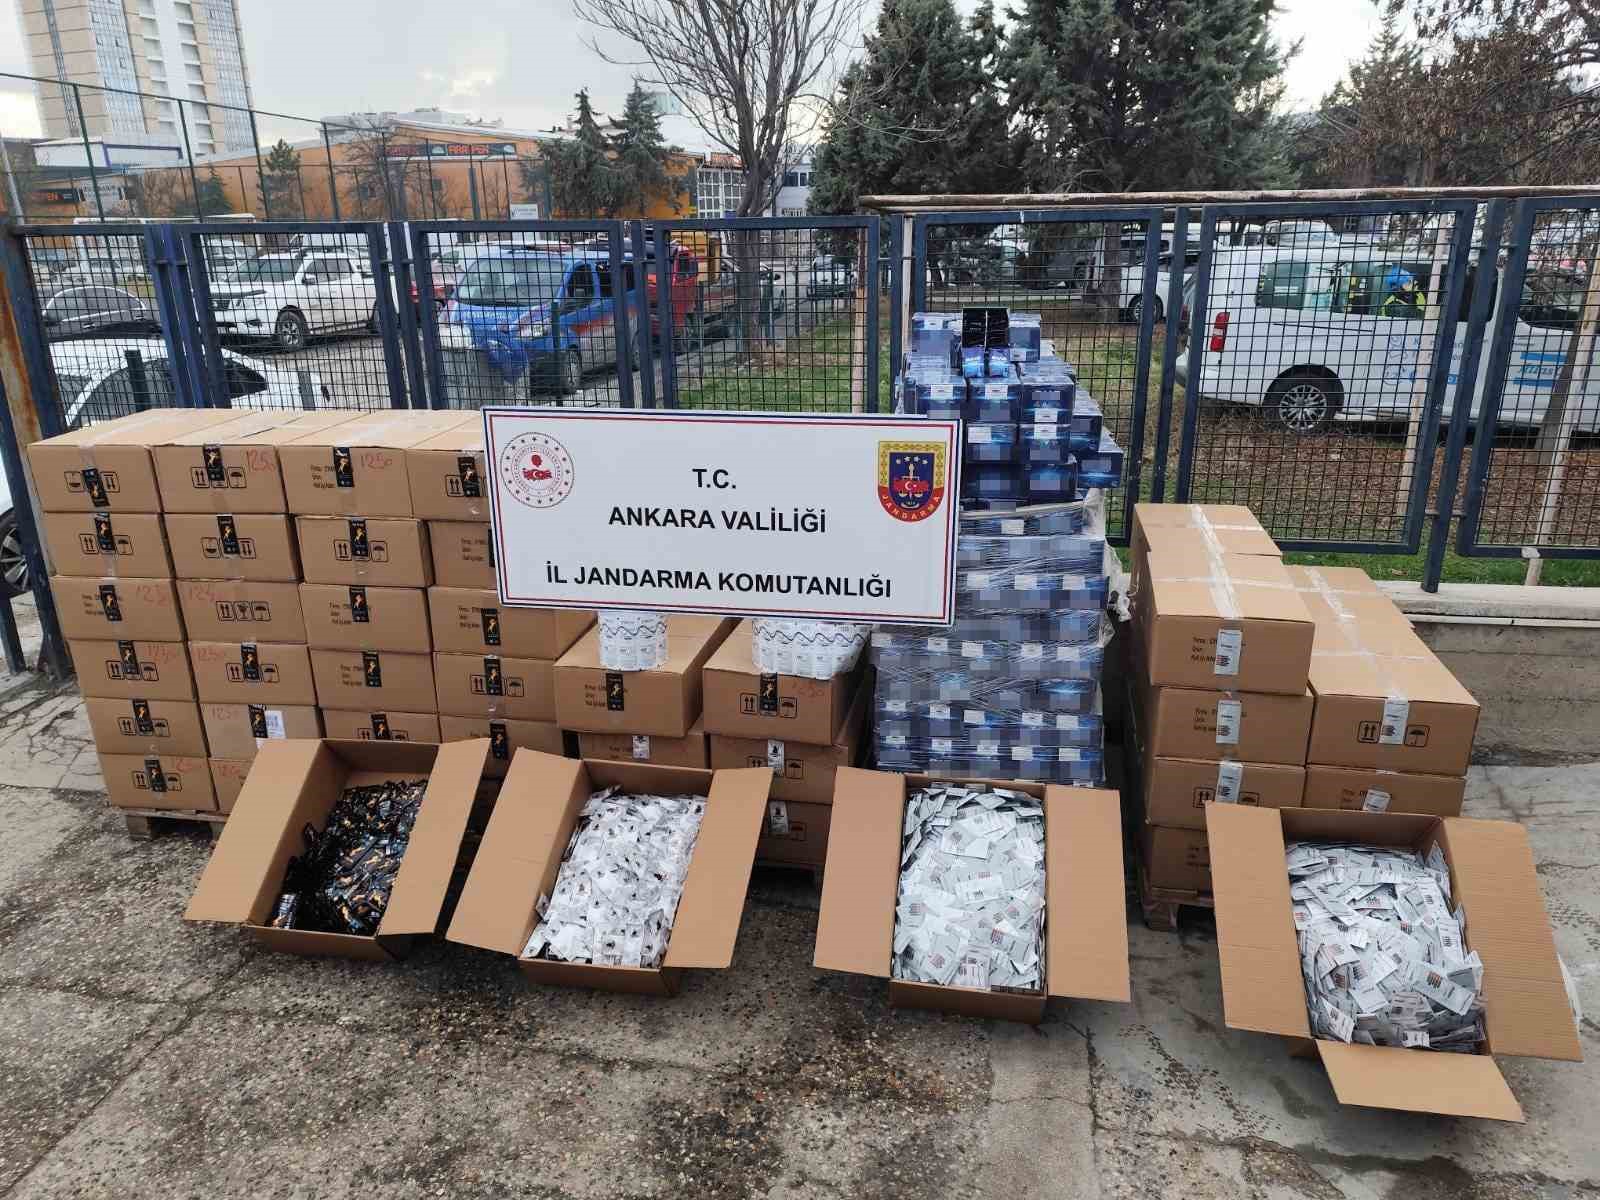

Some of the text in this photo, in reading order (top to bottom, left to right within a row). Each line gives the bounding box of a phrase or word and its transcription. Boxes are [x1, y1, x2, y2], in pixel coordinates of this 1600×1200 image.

[692, 468, 737, 489] T.C.
[608, 506, 826, 533] ANKARA VALİLİĞİ
[882, 494, 941, 520] JANDARMA
[546, 560, 891, 598] İL JANDARMA KOMUTANLIĞI
